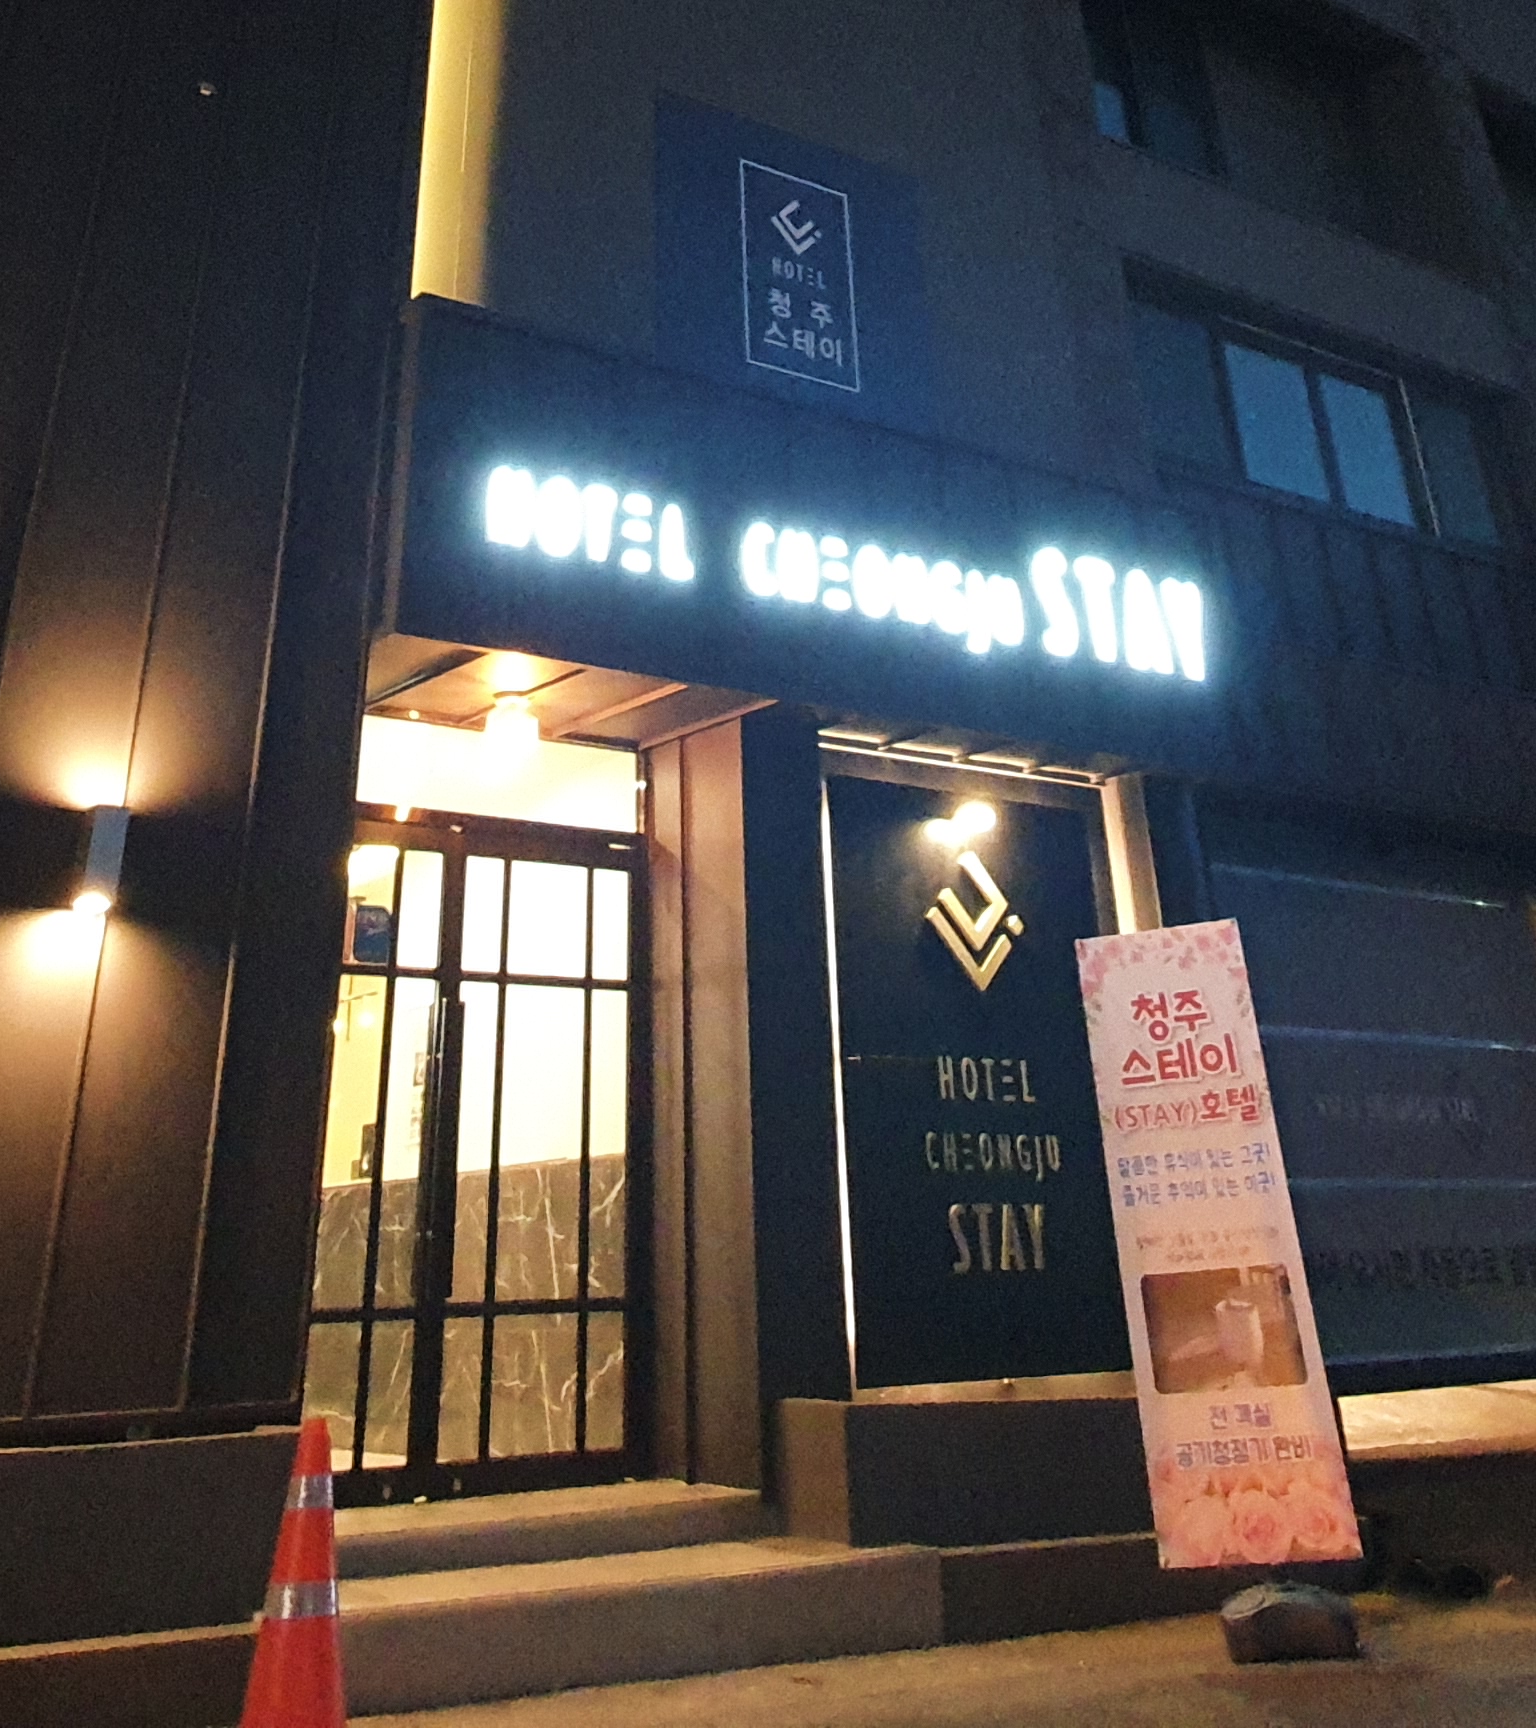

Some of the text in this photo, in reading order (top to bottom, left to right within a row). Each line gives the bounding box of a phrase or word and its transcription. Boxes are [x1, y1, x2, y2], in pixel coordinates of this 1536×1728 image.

[771, 256, 826, 290] HOTEL
[763, 320, 843, 367] 스테이
[484, 465, 695, 583] HOTEL
[1028, 545, 1206, 683] STAY
[1130, 989, 1208, 1042] 청주
[936, 1055, 1037, 1104] HOTEL
[1120, 1032, 1238, 1086] 스테이
[924, 1130, 1062, 1183] CHEONGJU
[1206, 1148, 1234, 1168] 있는
[948, 1202, 1046, 1273] STAY
[1175, 1437, 1269, 1468] 공기청정기
